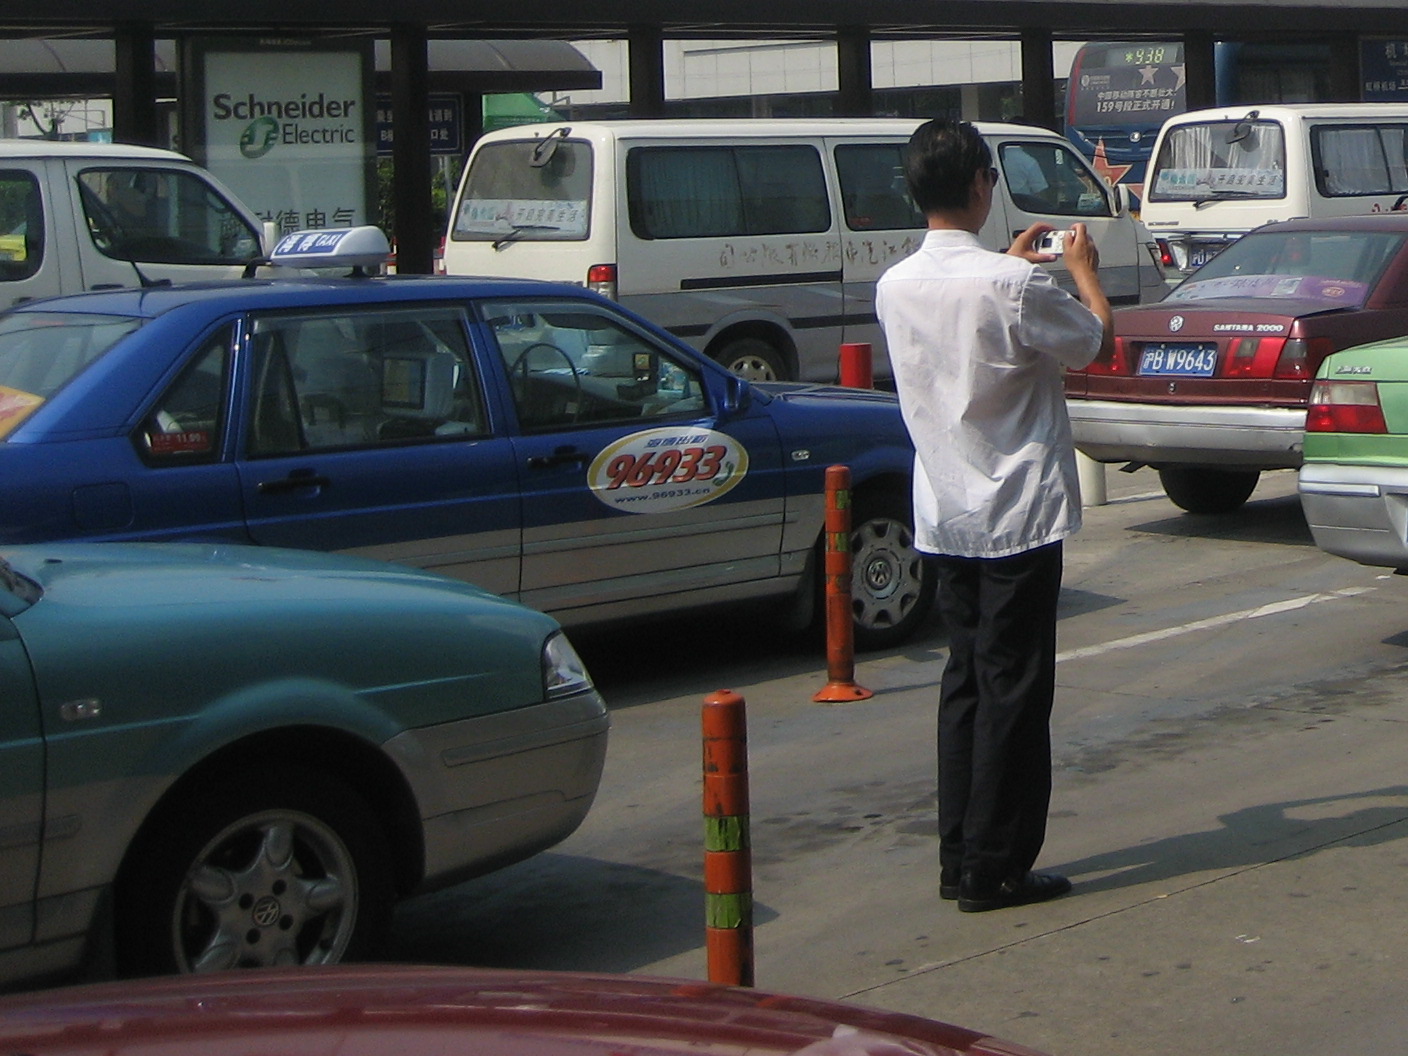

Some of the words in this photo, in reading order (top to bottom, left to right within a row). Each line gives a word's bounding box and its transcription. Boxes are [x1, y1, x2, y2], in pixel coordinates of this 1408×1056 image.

[213, 93, 356, 120] Schneider
[282, 123, 356, 145] Electric
[315, 234, 343, 246] TAXI
[1213, 322, 1253, 332] SANTANA
[1256, 323, 1284, 332] 2000
[606, 445, 727, 490] 96933
[614, 488, 710, 504] www.96933.cn
